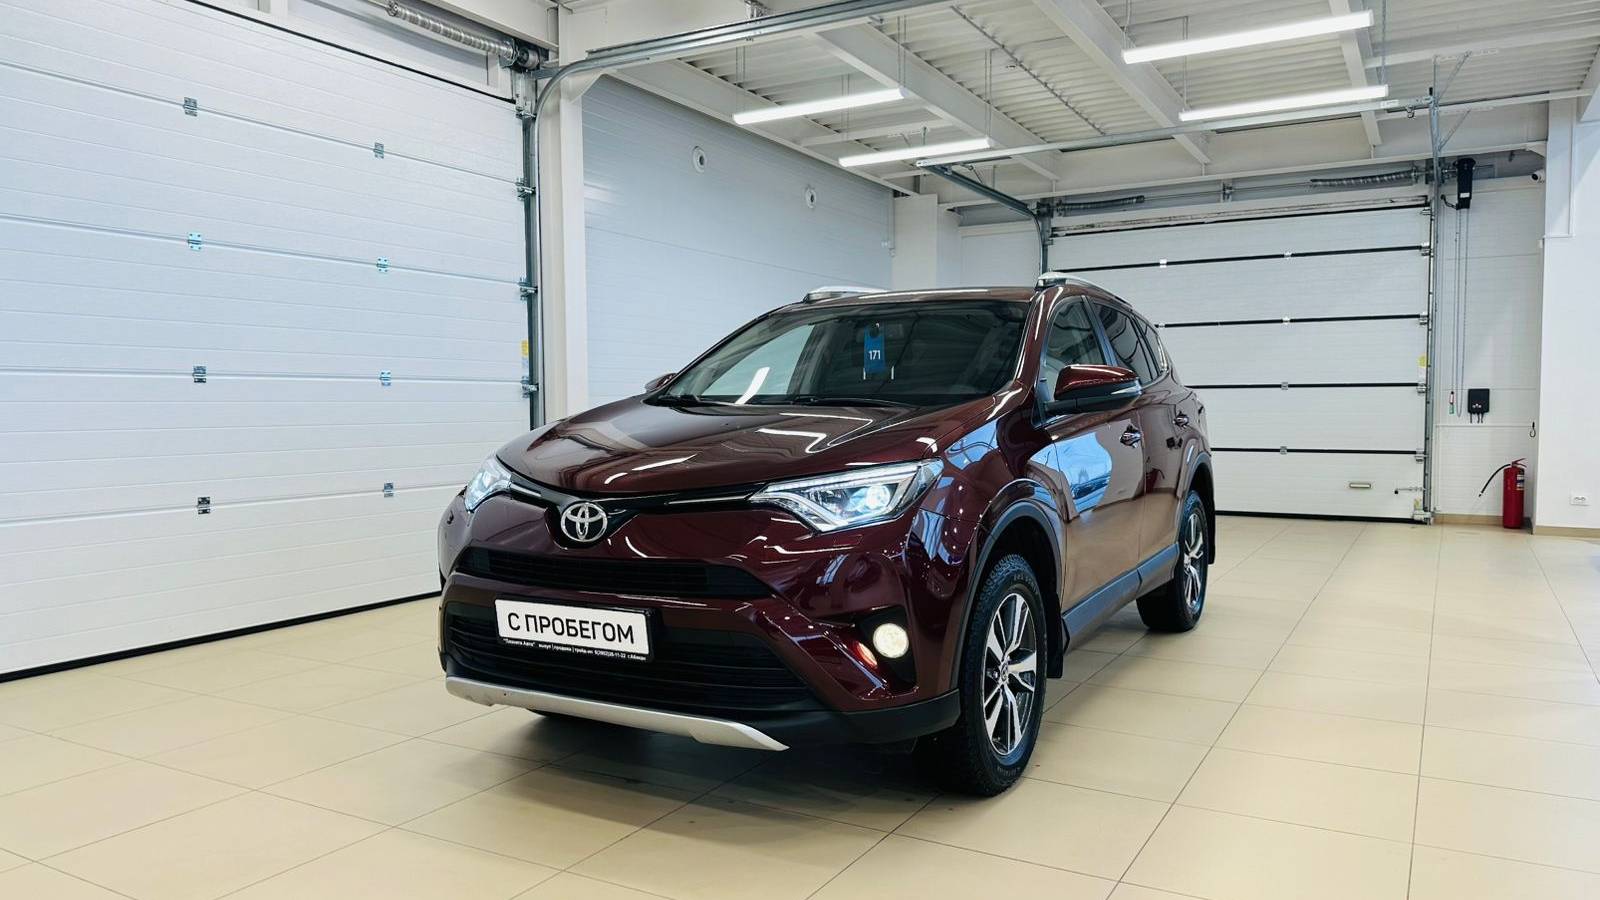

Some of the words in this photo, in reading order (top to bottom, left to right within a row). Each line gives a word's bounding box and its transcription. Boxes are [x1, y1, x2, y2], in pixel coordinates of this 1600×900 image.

[868, 349, 881, 361] 171
[507, 612, 521, 631] С
[524, 614, 634, 645] ПРОБЕГОМ
